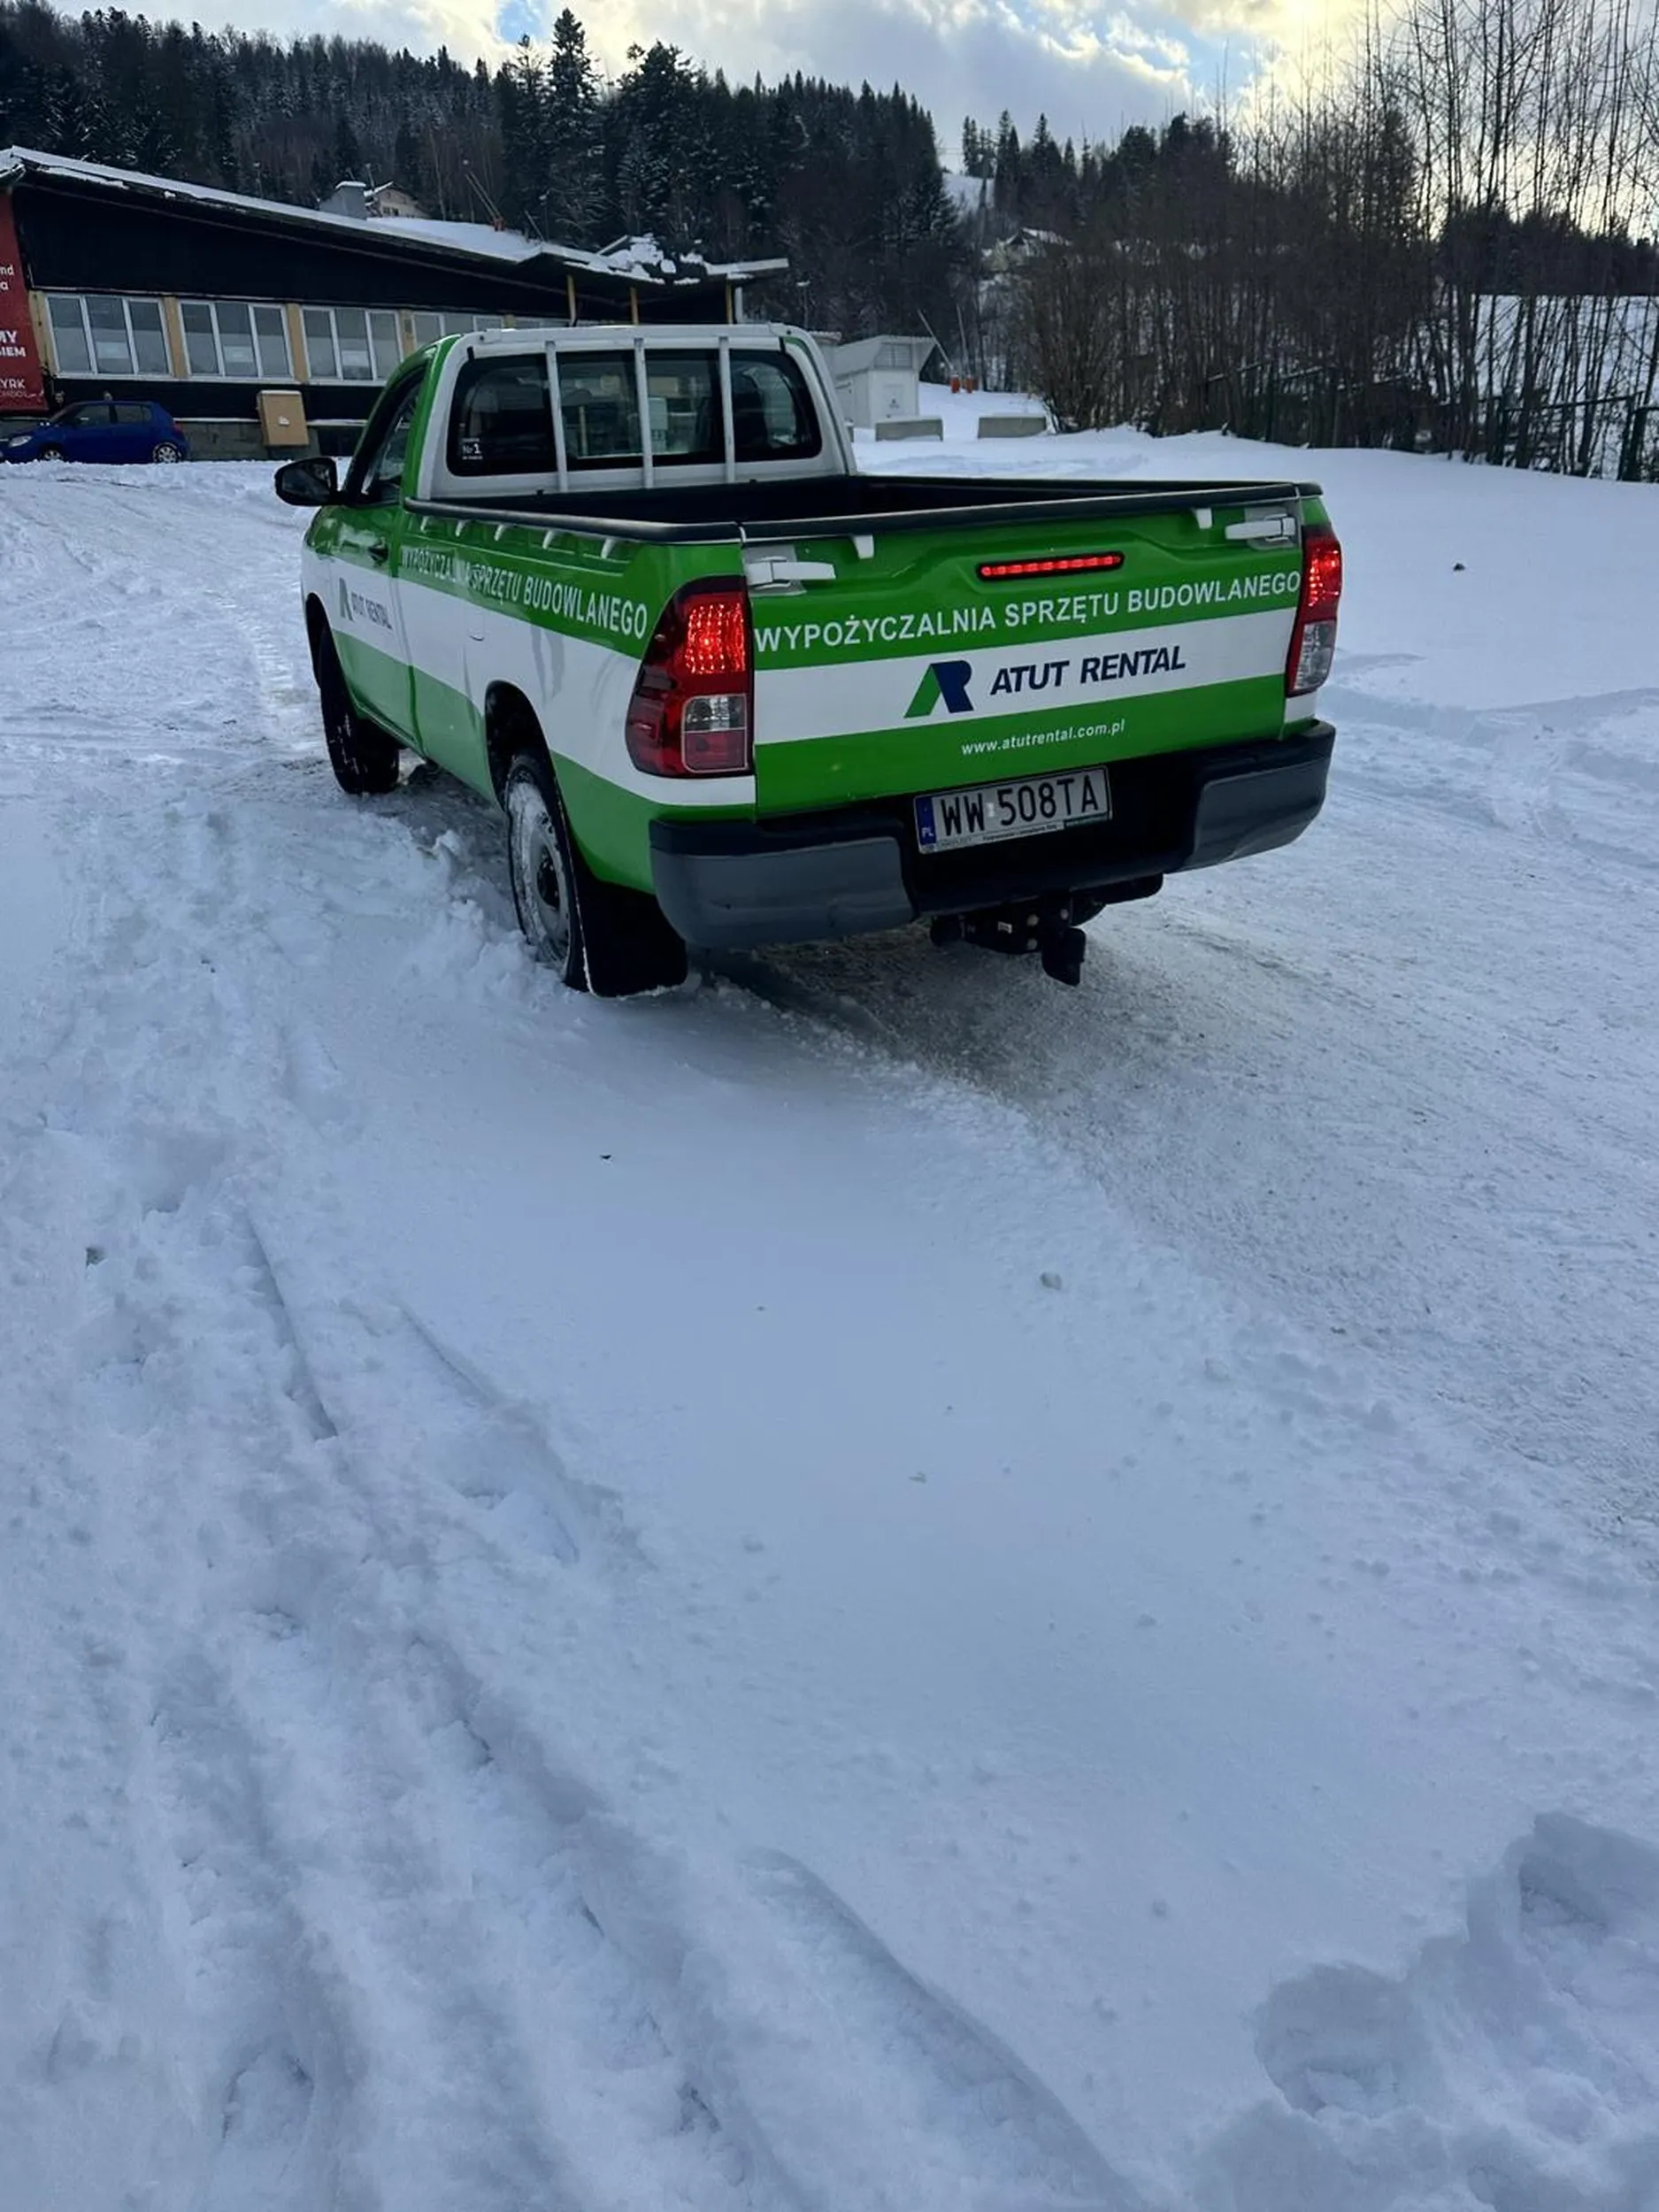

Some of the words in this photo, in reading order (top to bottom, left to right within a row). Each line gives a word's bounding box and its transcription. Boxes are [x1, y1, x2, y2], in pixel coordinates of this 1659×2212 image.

[472, 565, 522, 605] SPRZĘTU
[524, 576, 648, 639] BUDOWLANEGO
[754, 607, 996, 653] WYPOŻYCZALNIA
[1005, 593, 1119, 626] SPRZĘTU
[1127, 570, 1301, 613] BUDOWLANEGO
[990, 660, 1070, 695] ATUT
[1079, 646, 1187, 685] RENTAL
[962, 718, 1125, 756] www.atutrental.com.pl
[941, 793, 985, 836] WW
[997, 775, 1099, 826] 508TA
